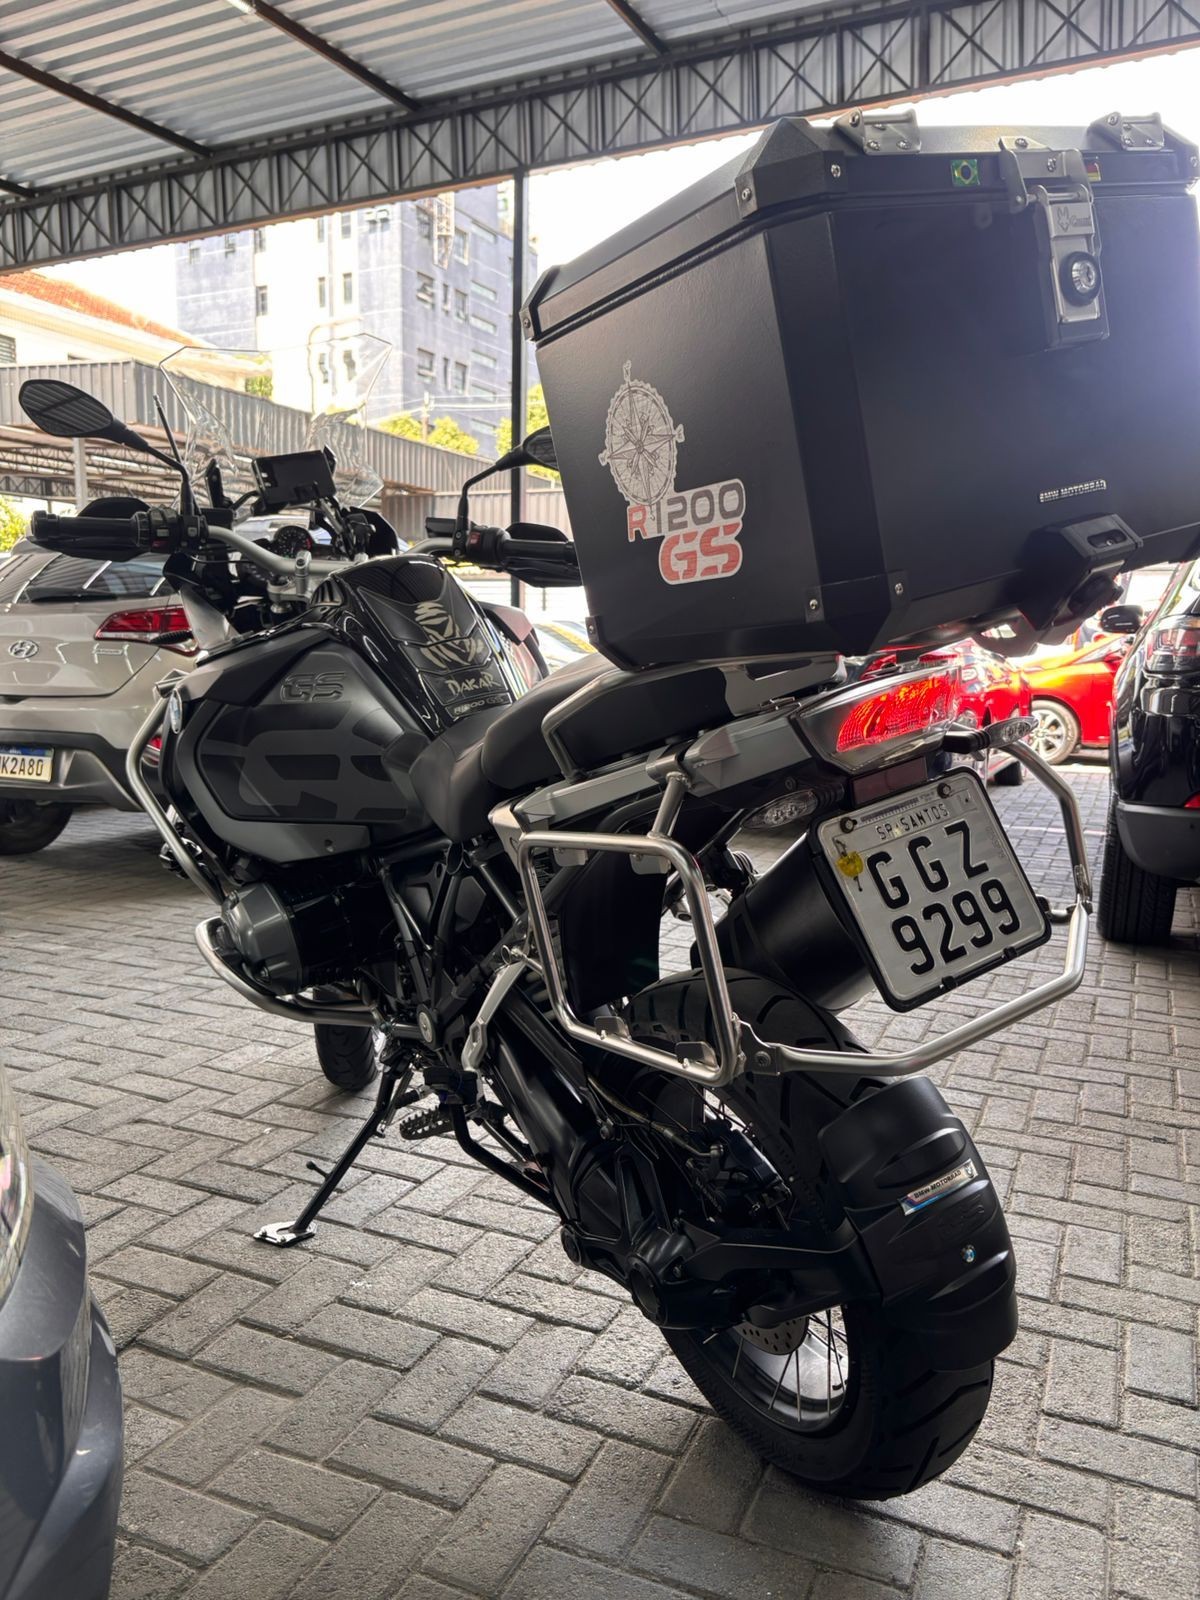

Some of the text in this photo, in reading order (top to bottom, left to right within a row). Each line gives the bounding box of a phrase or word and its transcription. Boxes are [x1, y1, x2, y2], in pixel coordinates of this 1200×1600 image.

[626, 481, 745, 541] R1200
[660, 522, 742, 582] GS
[280, 671, 345, 703] GS
[444, 671, 502, 696] DAKAR
[0, 756, 44, 777] K2A80
[900, 804, 949, 831] SANTOS
[866, 820, 990, 910] GGZ
[891, 878, 1021, 976] 9299
[931, 1170, 962, 1190] MOTORRAD
